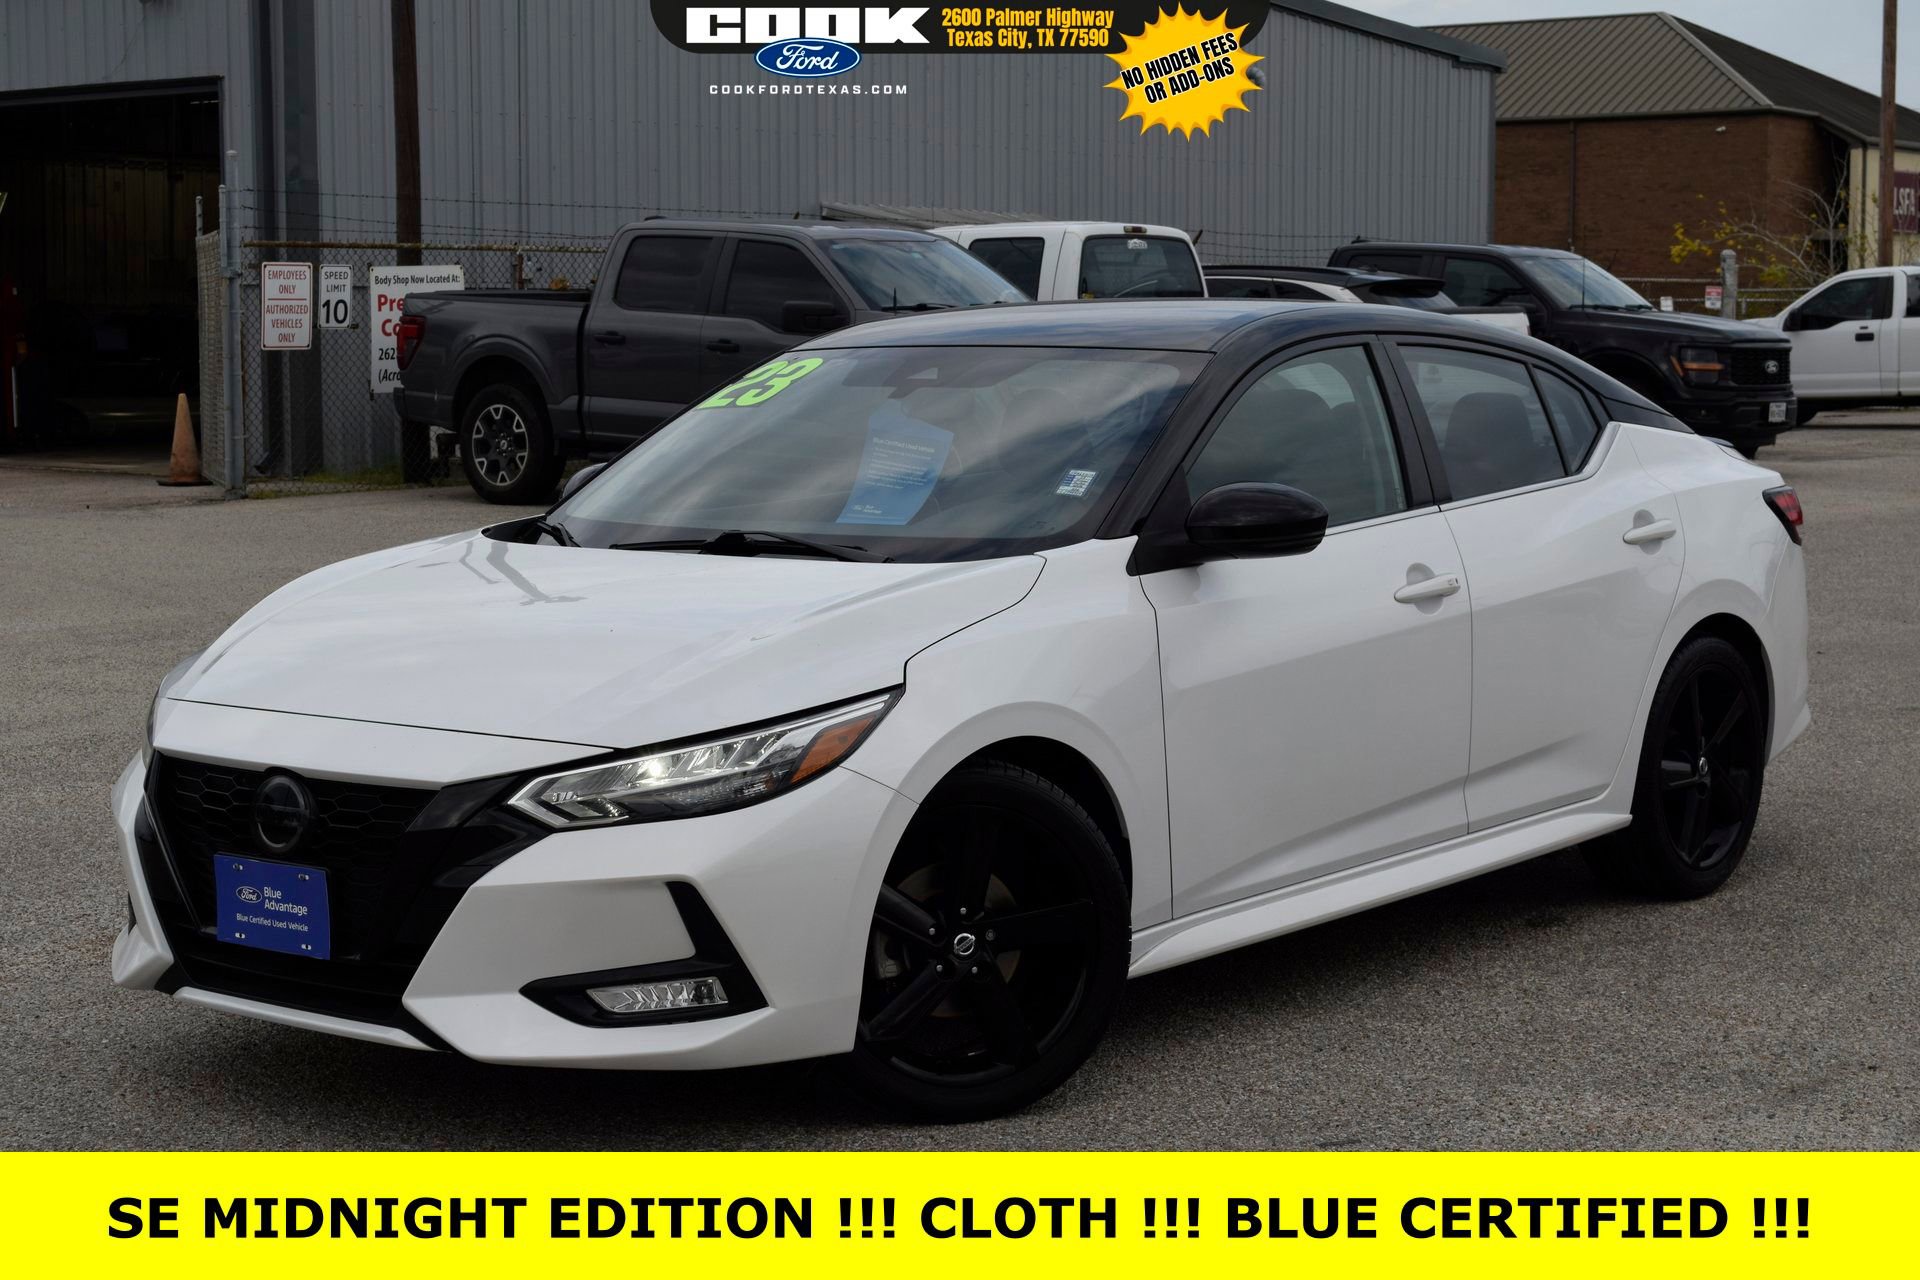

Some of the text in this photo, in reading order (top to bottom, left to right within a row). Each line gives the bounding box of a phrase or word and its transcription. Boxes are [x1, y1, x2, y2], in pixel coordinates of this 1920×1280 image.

[268, 270, 307, 280] EMPLOYEES
[324, 271, 349, 280] SPEED
[374, 274, 460, 286] Body Shop Now Located At:
[278, 284, 296, 294] ONLY
[326, 284, 346, 293] LIMIT
[377, 293, 405, 312] Pre
[266, 304, 308, 315] AUTHORIZED
[322, 299, 348, 324] 10
[271, 319, 303, 328] VEHICLES
[278, 333, 296, 342] ONLY
[697, 357, 823, 410] 23
[240, 888, 258, 901] Ford
[263, 886, 282, 899] Blue
[264, 899, 308, 916] Advantage
[236, 913, 309, 932] Blue Certified Used Vehicle
